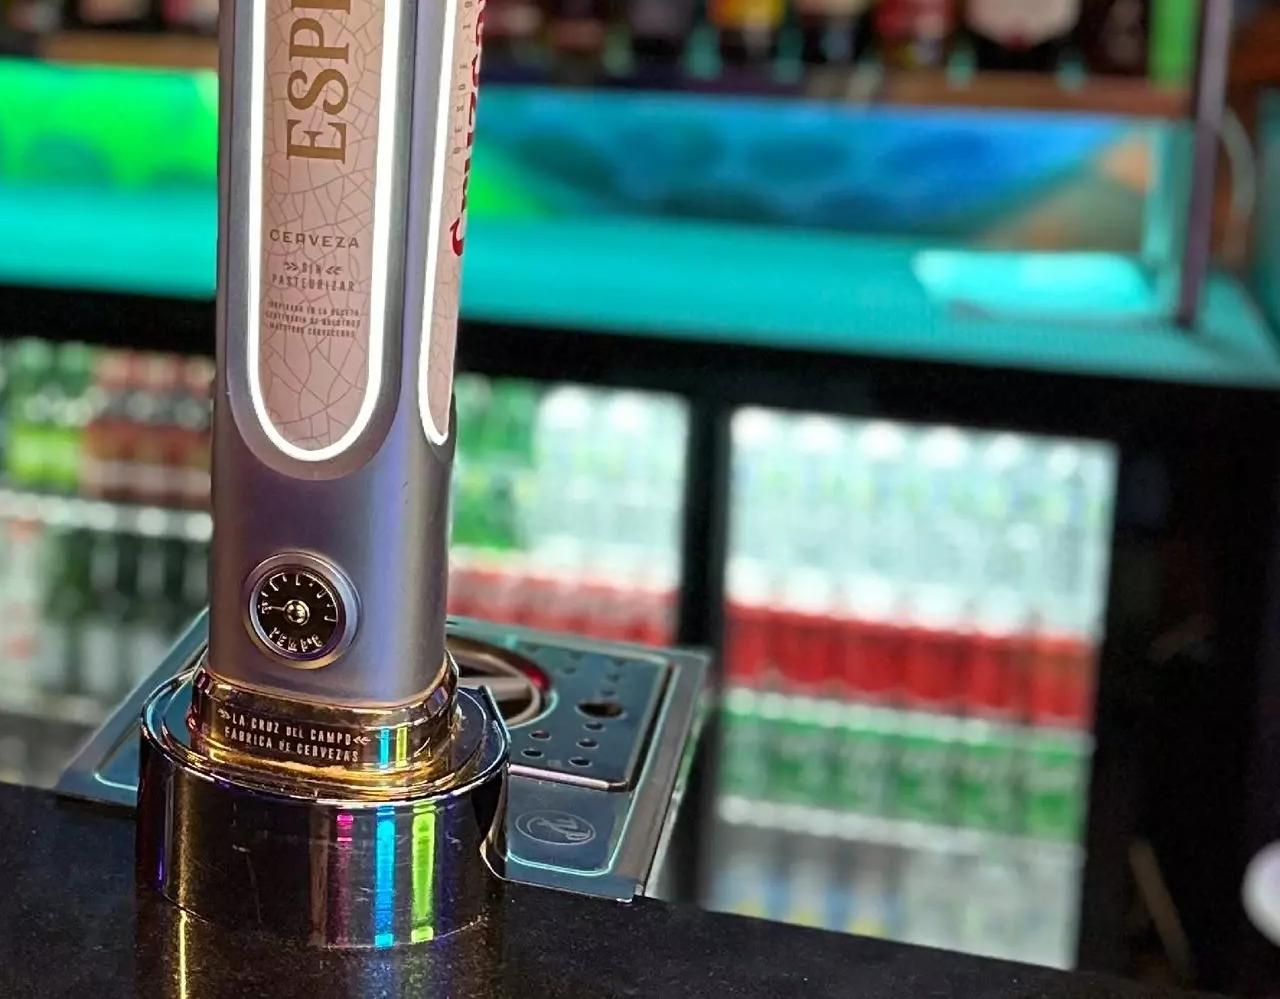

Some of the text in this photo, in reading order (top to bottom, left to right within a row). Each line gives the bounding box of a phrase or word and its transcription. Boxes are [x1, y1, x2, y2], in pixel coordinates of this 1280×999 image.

[269, 228, 360, 249] CERVEZA
[232, 713, 352, 746] LA CRUZ DEL CAMPO
[296, 744, 359, 762] CERVEZAS
